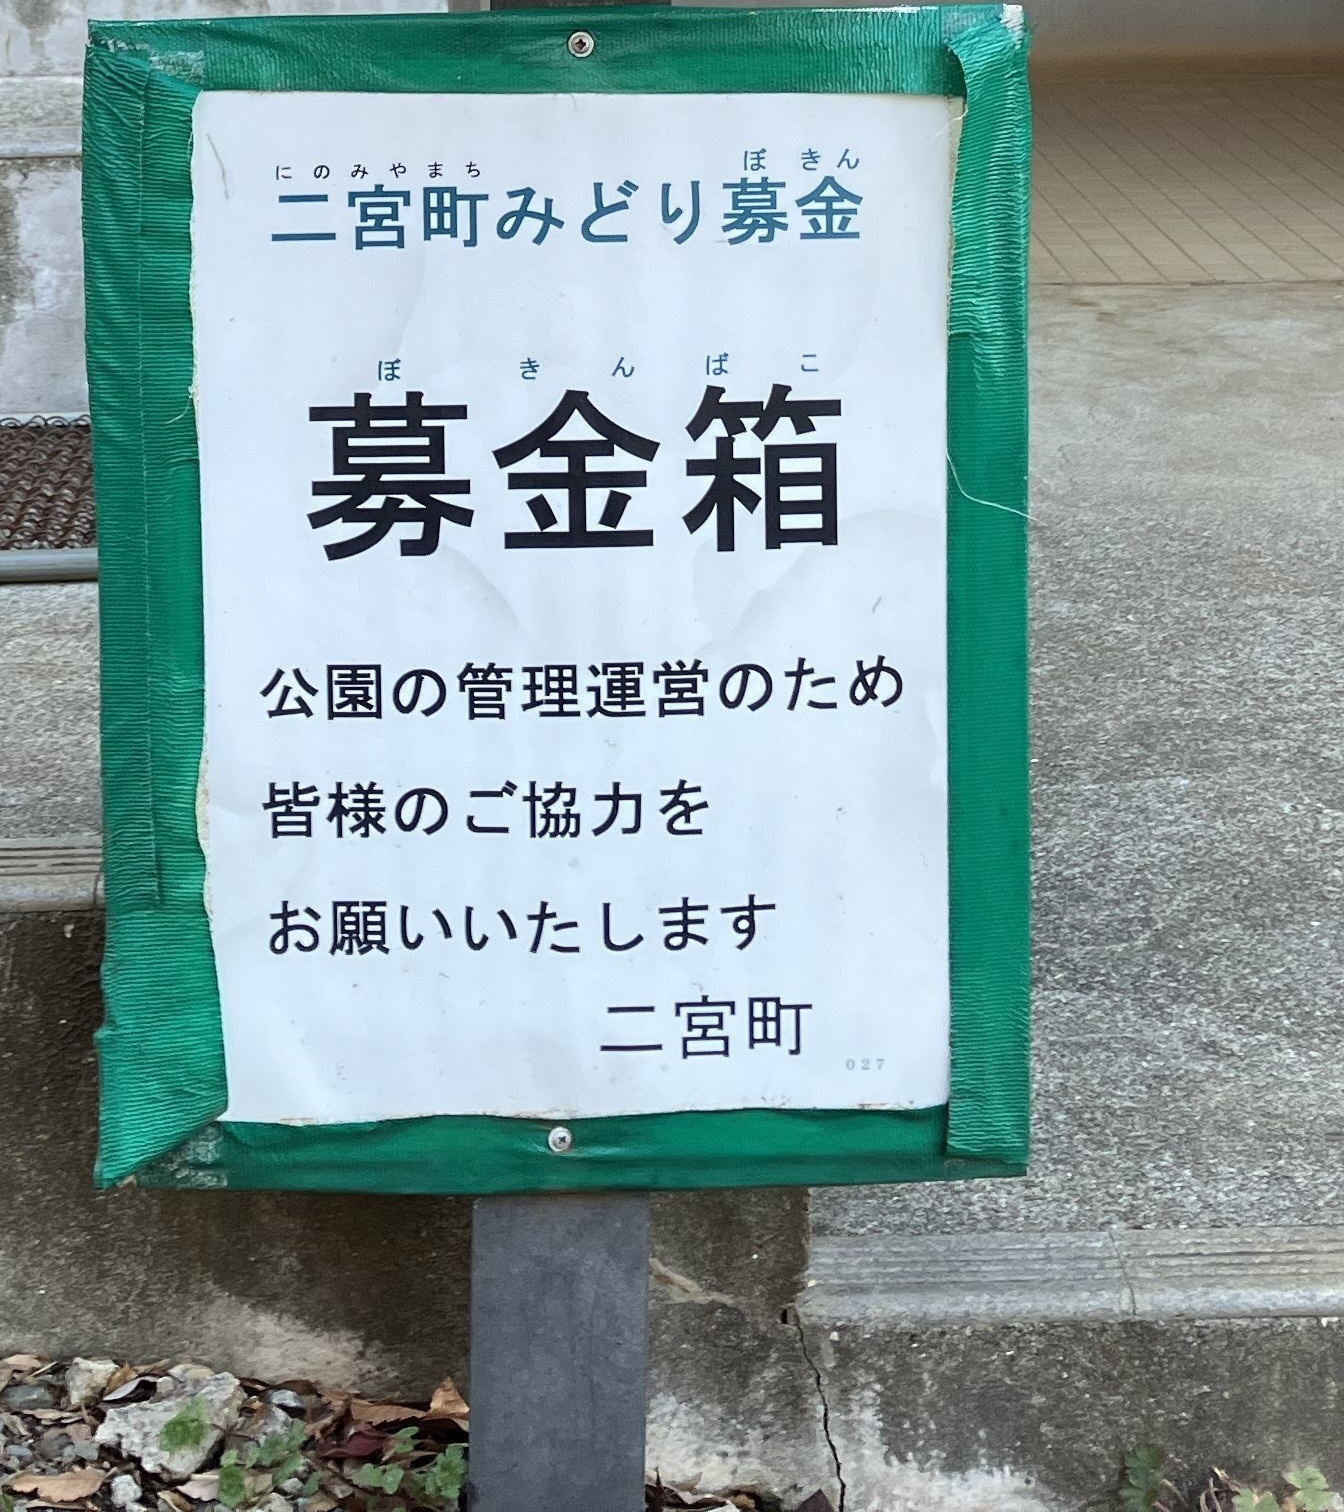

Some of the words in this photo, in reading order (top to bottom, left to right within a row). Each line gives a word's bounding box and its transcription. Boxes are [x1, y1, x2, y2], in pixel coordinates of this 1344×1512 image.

[275, 161, 481, 181] にのみやまち
[743, 147, 860, 172] ぼきん
[271, 174, 864, 251] 二宮町みどり募金
[306, 383, 842, 562] 募金箱
[260, 654, 903, 721] 公園の管理運営のため
[261, 778, 709, 839] 皆様のご協力を
[269, 893, 776, 956] お願いいたします
[600, 994, 813, 1060] 二宮町
[846, 1058, 885, 1070] 027
